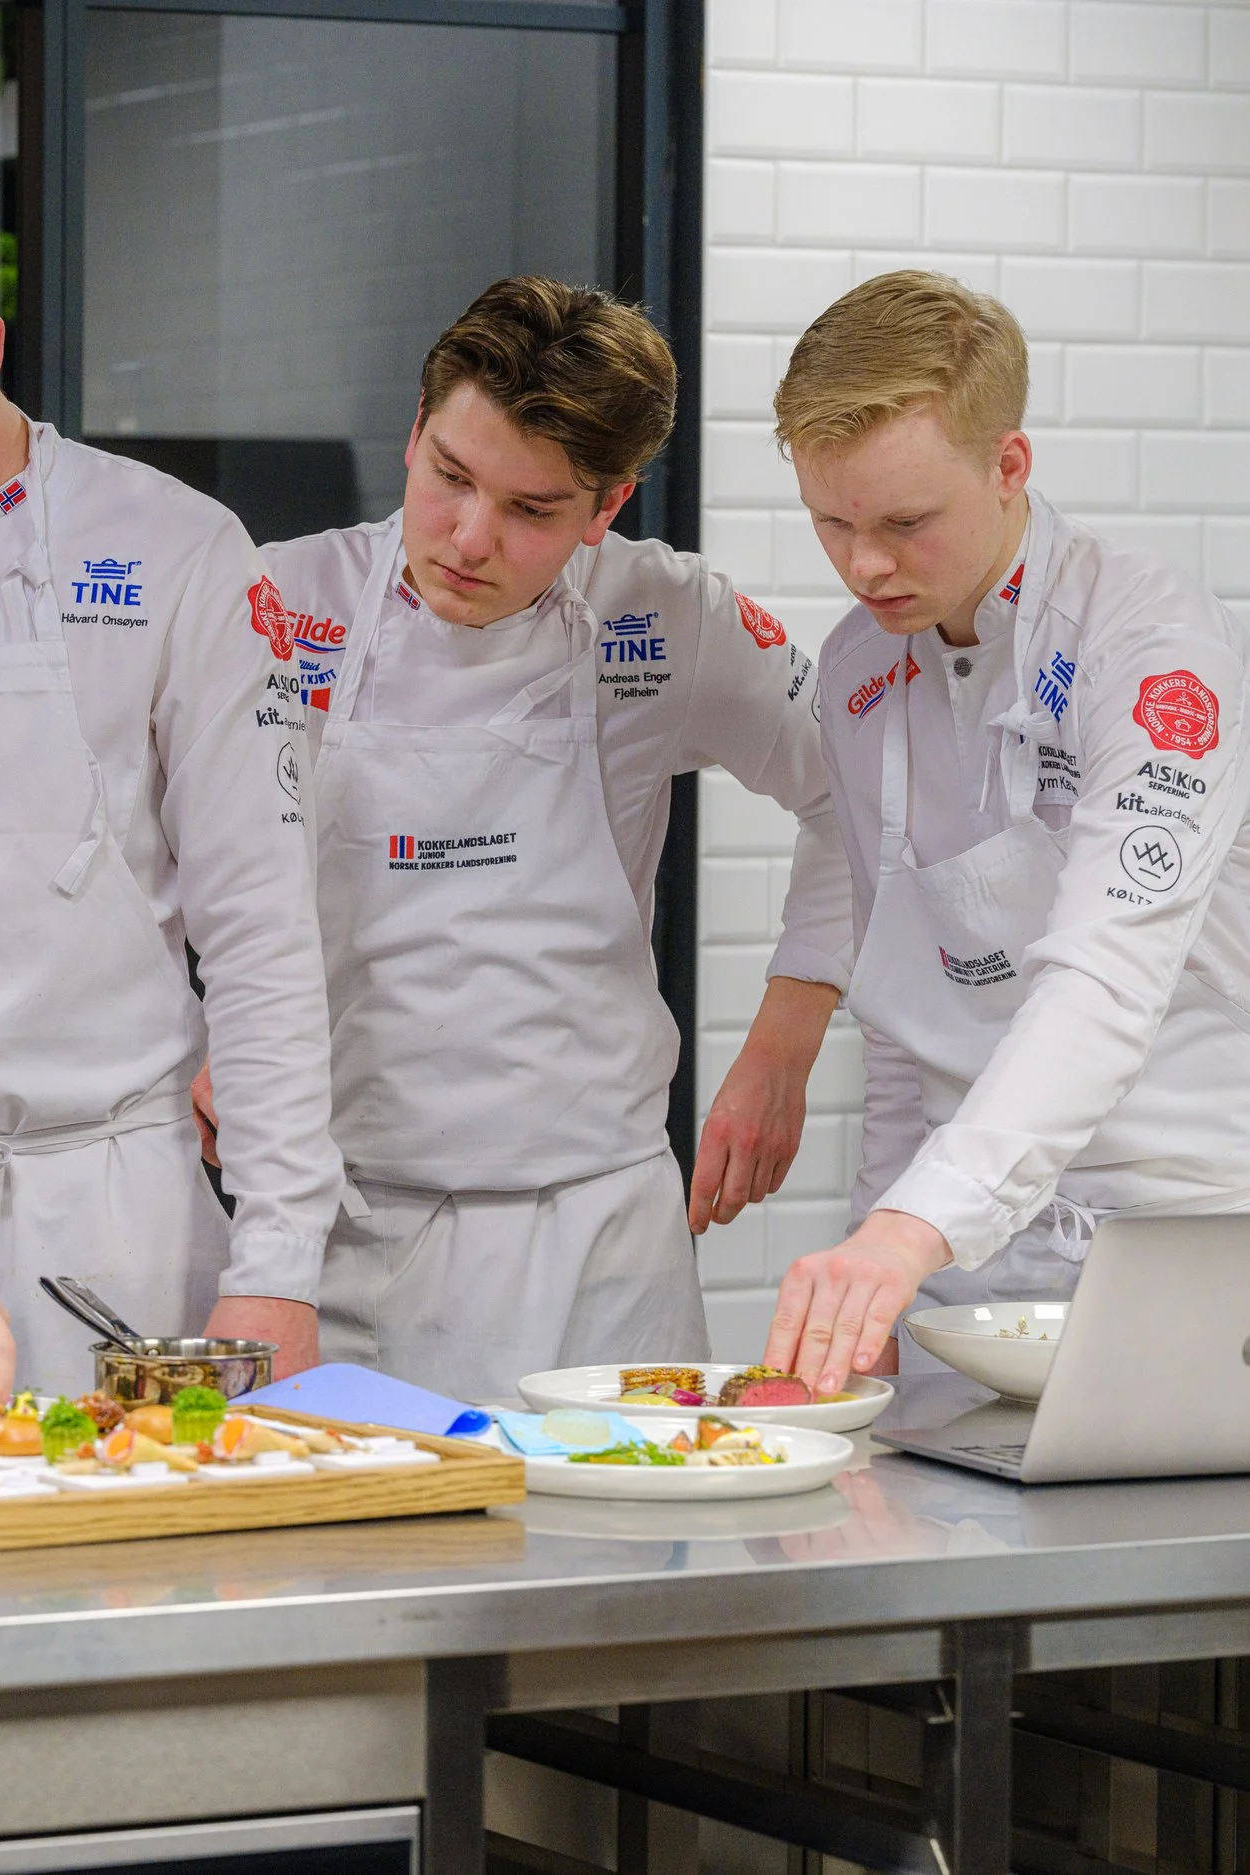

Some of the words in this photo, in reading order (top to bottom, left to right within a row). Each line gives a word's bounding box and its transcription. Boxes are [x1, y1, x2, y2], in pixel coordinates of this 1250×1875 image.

[72, 582, 143, 606] TINE
[61, 613, 99, 625] Håvard
[102, 615, 149, 629] Onsøyen
[601, 638, 667, 663] TINE
[299, 660, 320, 671] lltid
[598, 673, 640, 684] Andreas
[643, 671, 672, 684] Enger
[614, 687, 659, 700] Fjellheim
[848, 676, 886, 715] Gilde
[1035, 668, 1069, 724] TINE
[1148, 678, 1187, 701] KOKKERS
[1145, 700, 1166, 733] NORSKE
[1188, 681, 1215, 746] LANDSFORENING
[1170, 733, 1192, 746] 1954
[1148, 780, 1190, 799] SERVERING
[417, 832, 517, 851] KOKKELANDSLAGET
[389, 861, 419, 871] NORSKE
[421, 861, 454, 870] KOKKERS
[456, 854, 517, 869] LANDSFORENING
[417, 851, 445, 860] JUNIOR
[975, 959, 1011, 977] CATERING
